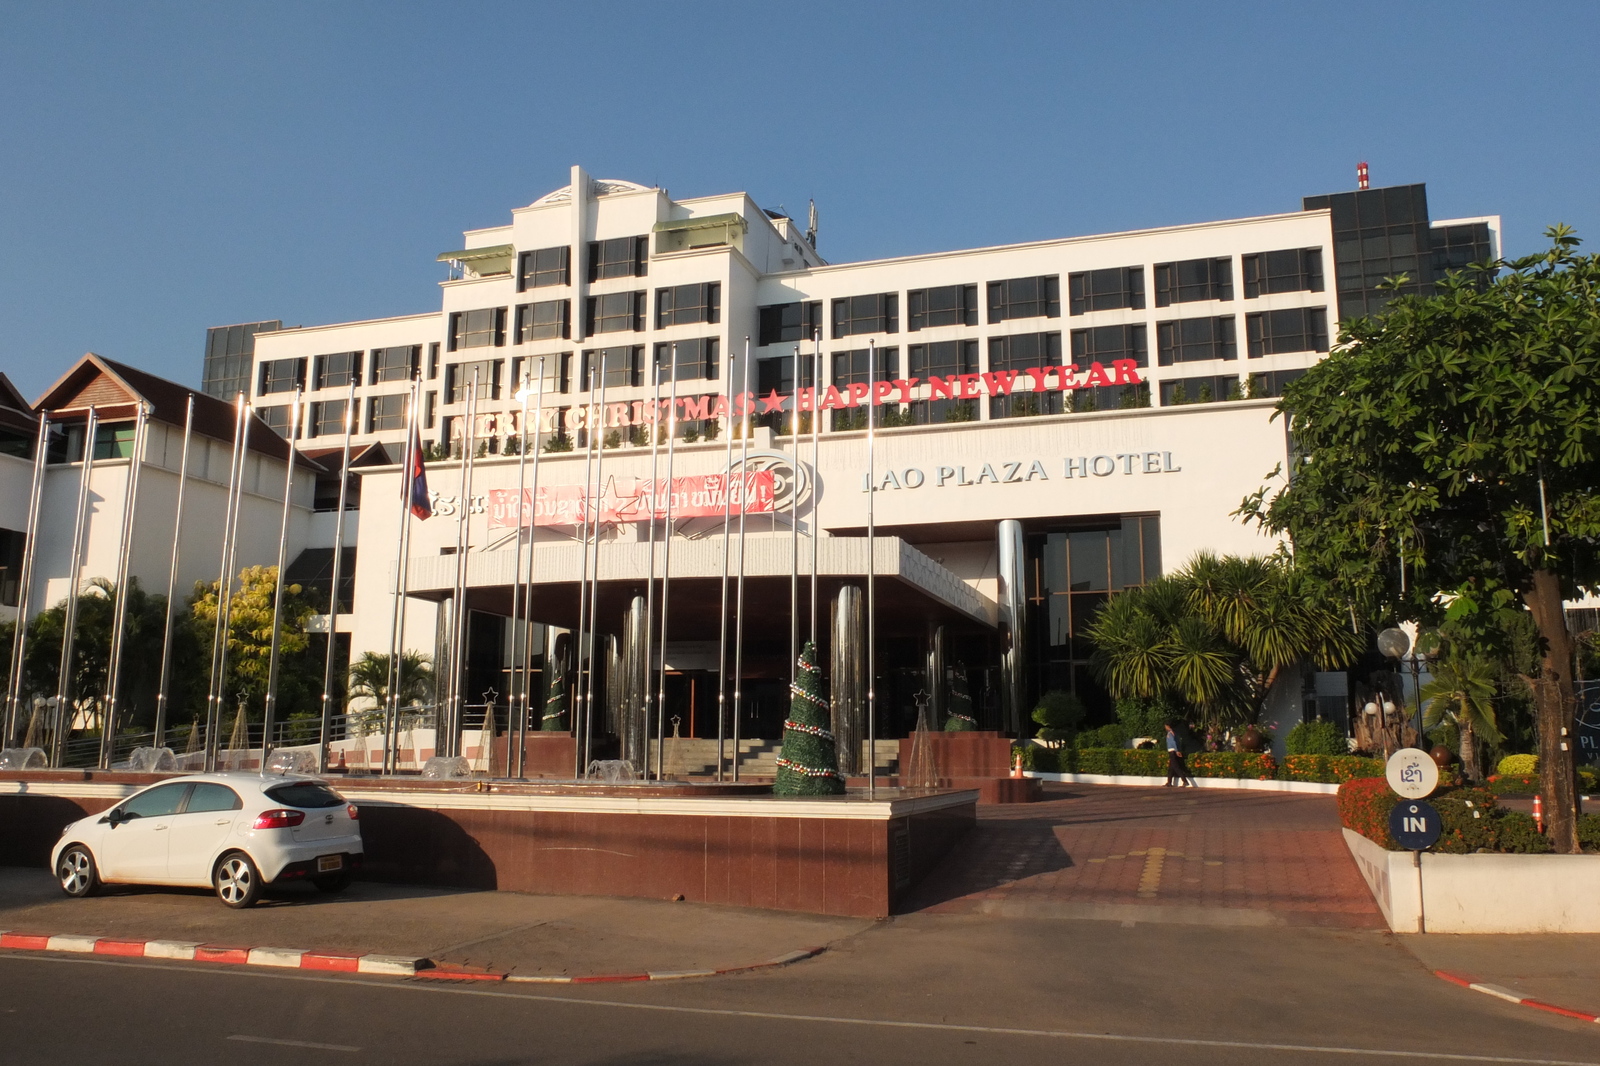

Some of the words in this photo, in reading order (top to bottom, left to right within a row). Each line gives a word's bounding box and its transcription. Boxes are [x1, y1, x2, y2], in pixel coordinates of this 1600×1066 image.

[451, 408, 558, 439] MERRY
[565, 391, 756, 430] CHRISTMAS
[793, 377, 920, 412] HAPPY
[927, 369, 1019, 401] NEW
[1025, 358, 1143, 393] YEAR
[861, 467, 925, 493] LAO
[935, 460, 1049, 487] PLAZA
[1063, 451, 1182, 479] HOTEL
[1403, 817, 1427, 833] IN
